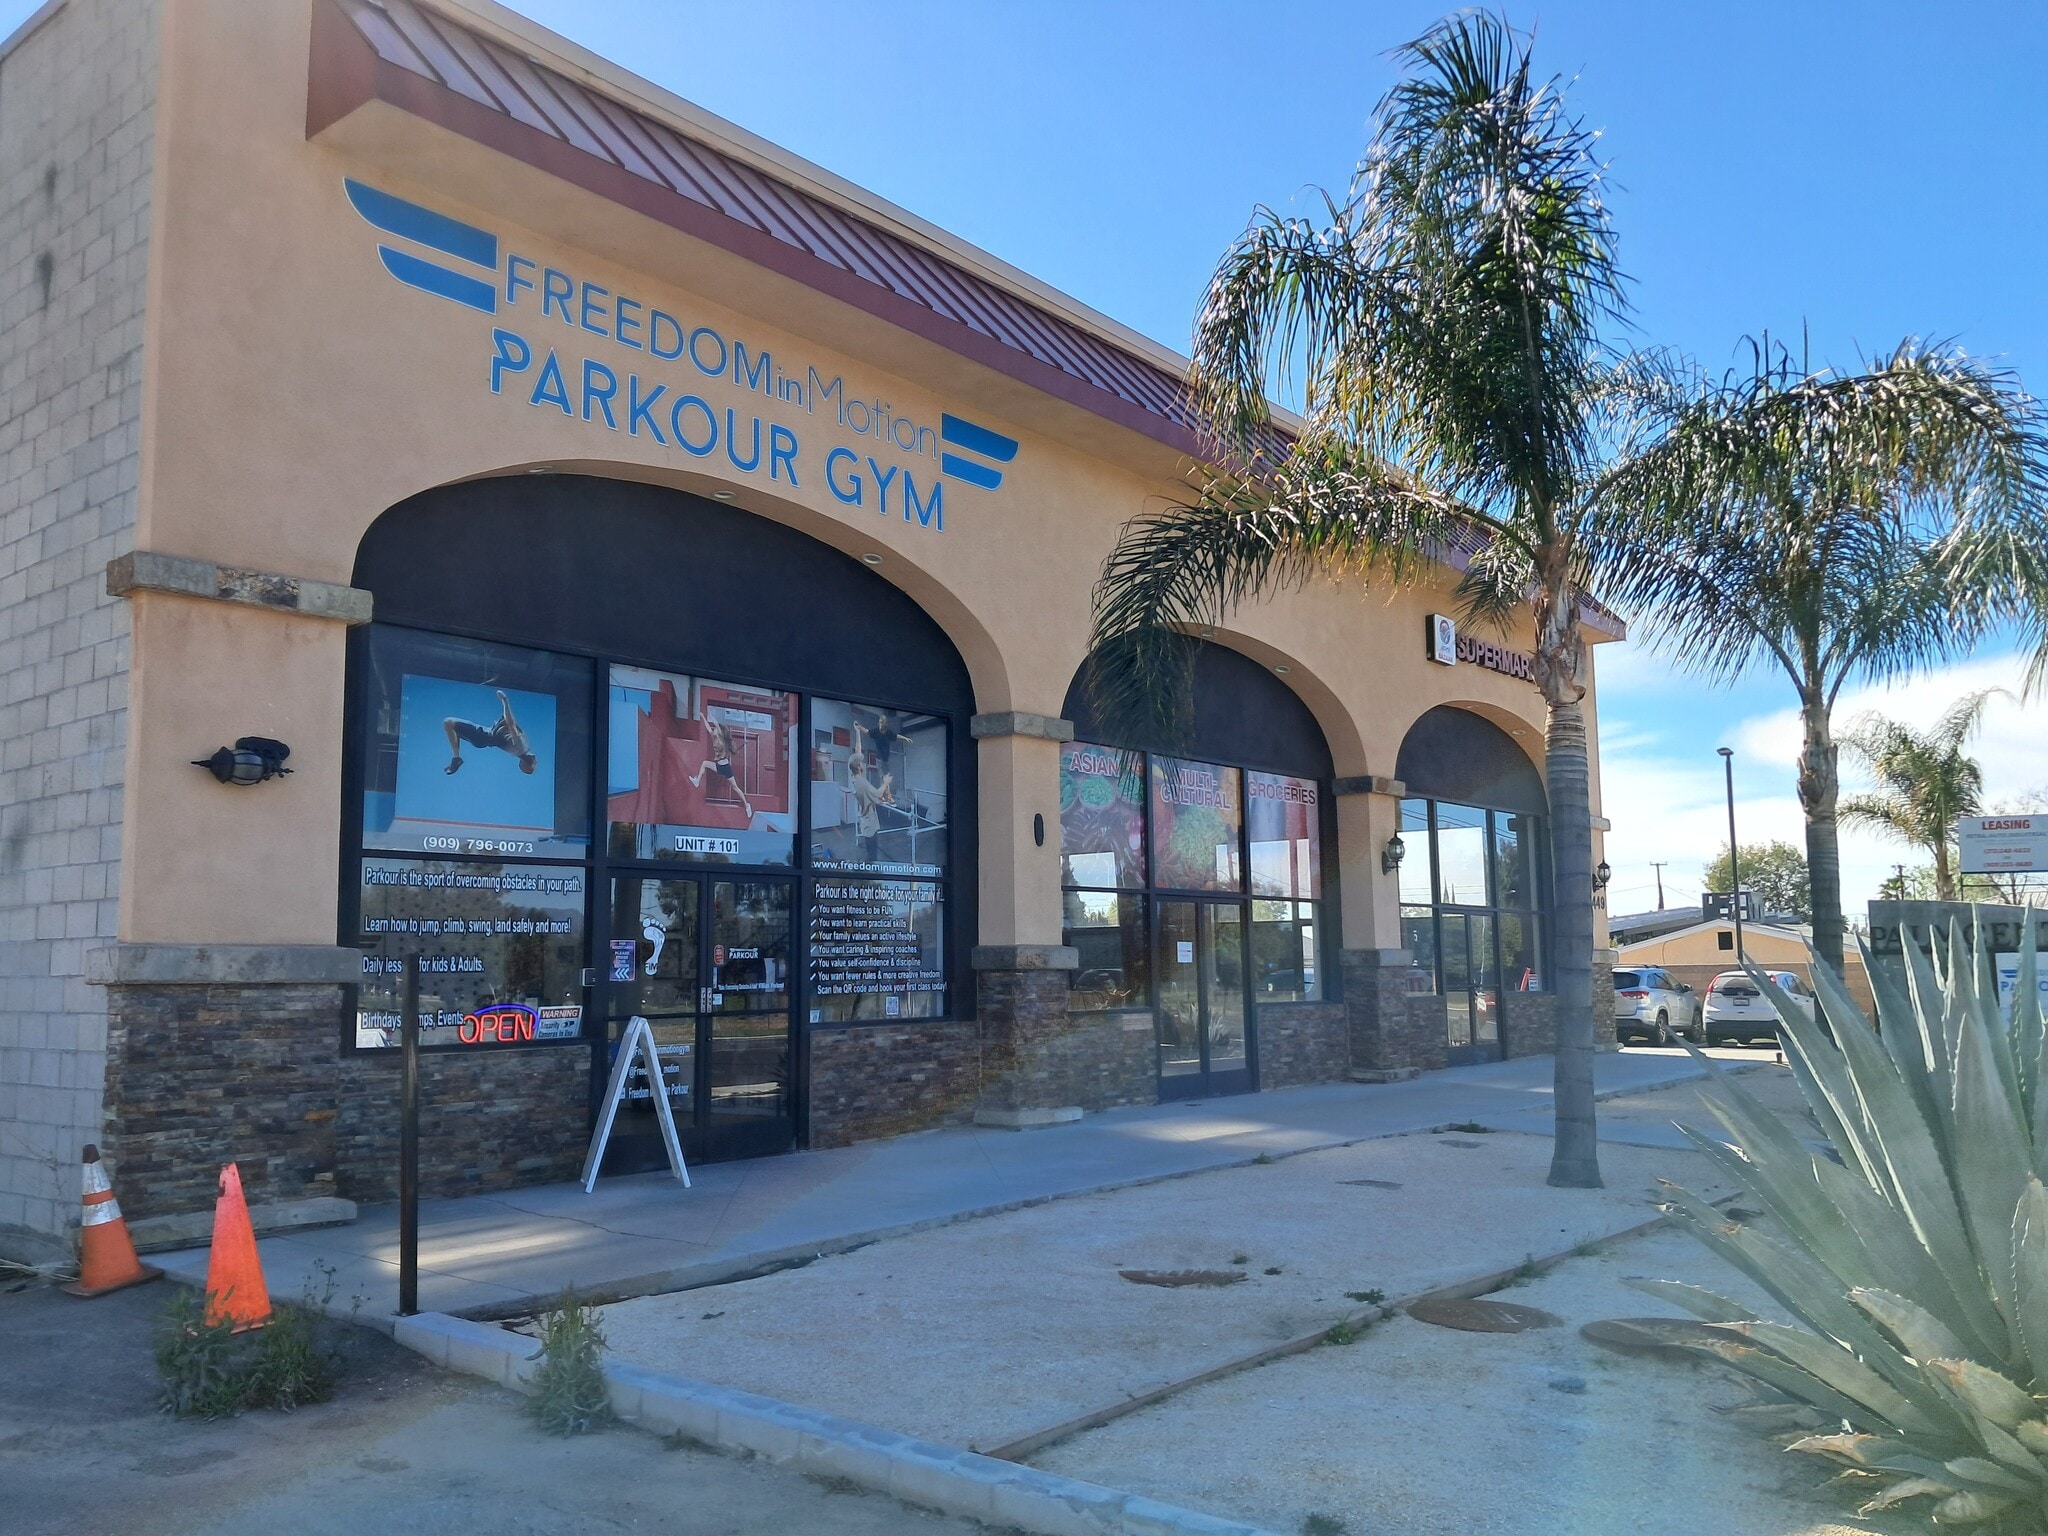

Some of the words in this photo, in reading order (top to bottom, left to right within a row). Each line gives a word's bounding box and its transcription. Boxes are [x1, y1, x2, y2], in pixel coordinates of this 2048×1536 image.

[490, 327, 800, 487] PARKOUR
[824, 446, 944, 533] GYM
[1456, 634, 1536, 681] SUPERMAR
[1070, 752, 1120, 777] ASIAN
[1161, 785, 1231, 811] CULTURAL
[1248, 779, 1315, 805] GROCERIES
[1982, 819, 2030, 830] LEASING
[423, 836, 460, 851] (909)
[467, 839, 533, 853] 796-0073
[676, 838, 704, 851] UNIT
[708, 840, 716, 851] #
[719, 840, 738, 852] 101
[813, 861, 941, 873] www.freedominmotion.com
[366, 867, 399, 884] Parkour
[400, 869, 407, 885] is
[409, 869, 422, 886] the
[423, 872, 445, 890] sport
[446, 871, 455, 886] of
[456, 873, 500, 892] overcoming
[502, 873, 536, 889] obstacles
[538, 875, 545, 890] in
[546, 879, 562, 895] your
[564, 876, 582, 895] path.
[816, 884, 840, 898] Parkour
[842, 885, 847, 898] is
[849, 885, 858, 899] the
[860, 885, 874, 902] right
[875, 886, 893, 900] choice
[919, 888, 935, 904] family
[819, 904, 829, 913] You
[831, 905, 845, 914] want
[847, 905, 865, 914] fitness
[866, 906, 872, 914] to
[873, 906, 880, 914] be
[881, 906, 893, 915] FUN
[365, 915, 388, 931] Learn
[390, 915, 408, 932] how
[409, 917, 418, 932] to
[418, 916, 442, 936] jump,
[443, 917, 467, 936] climb,
[468, 917, 493, 936] swing,
[494, 917, 511, 932] land
[512, 918, 534, 936] safely
[535, 918, 549, 933] and
[550, 919, 571, 933] more!
[819, 918, 829, 927] You
[831, 919, 845, 927] want
[846, 919, 852, 927] to
[853, 919, 867, 927] learn
[869, 919, 891, 929] practical
[819, 931, 832, 940] Your
[833, 931, 850, 942] family
[852, 932, 870, 940] values
[879, 932, 895, 940] active
[729, 951, 758, 959] PARKOUR
[819, 945, 829, 953] You
[831, 945, 845, 953] want
[846, 945, 863, 955] caring
[865, 945, 869, 953] &
[870, 945, 894, 955] inspiring
[895, 945, 917, 953] coaches
[363, 956, 385, 976] Daily
[386, 956, 403, 972] less
[419, 956, 431, 972] for
[432, 956, 449, 972] kids
[450, 957, 457, 972] &
[457, 956, 485, 972] Adults.
[818, 958, 829, 967] You
[831, 958, 846, 967] value
[847, 958, 889, 967] self-confidence
[890, 957, 895, 966] &
[818, 971, 829, 980] You
[831, 972, 845, 980] want
[846, 971, 861, 980] fewer
[862, 971, 876, 979] rules
[877, 970, 882, 979] &
[898, 971, 918, 979] creative
[920, 970, 940, 979] freedom
[817, 985, 831, 994] Scan
[833, 985, 842, 993] the
[843, 984, 852, 993] QR
[853, 984, 867, 992] code
[868, 983, 878, 992] and
[879, 983, 892, 991] book
[893, 984, 905, 993] your
[918, 982, 930, 991] class
[362, 1011, 401, 1031] Birthdays
[419, 1014, 436, 1031] mps,
[437, 1010, 466, 1026] Events.
[542, 1009, 578, 1018] WARNING
[458, 1013, 534, 1044] OPEN
